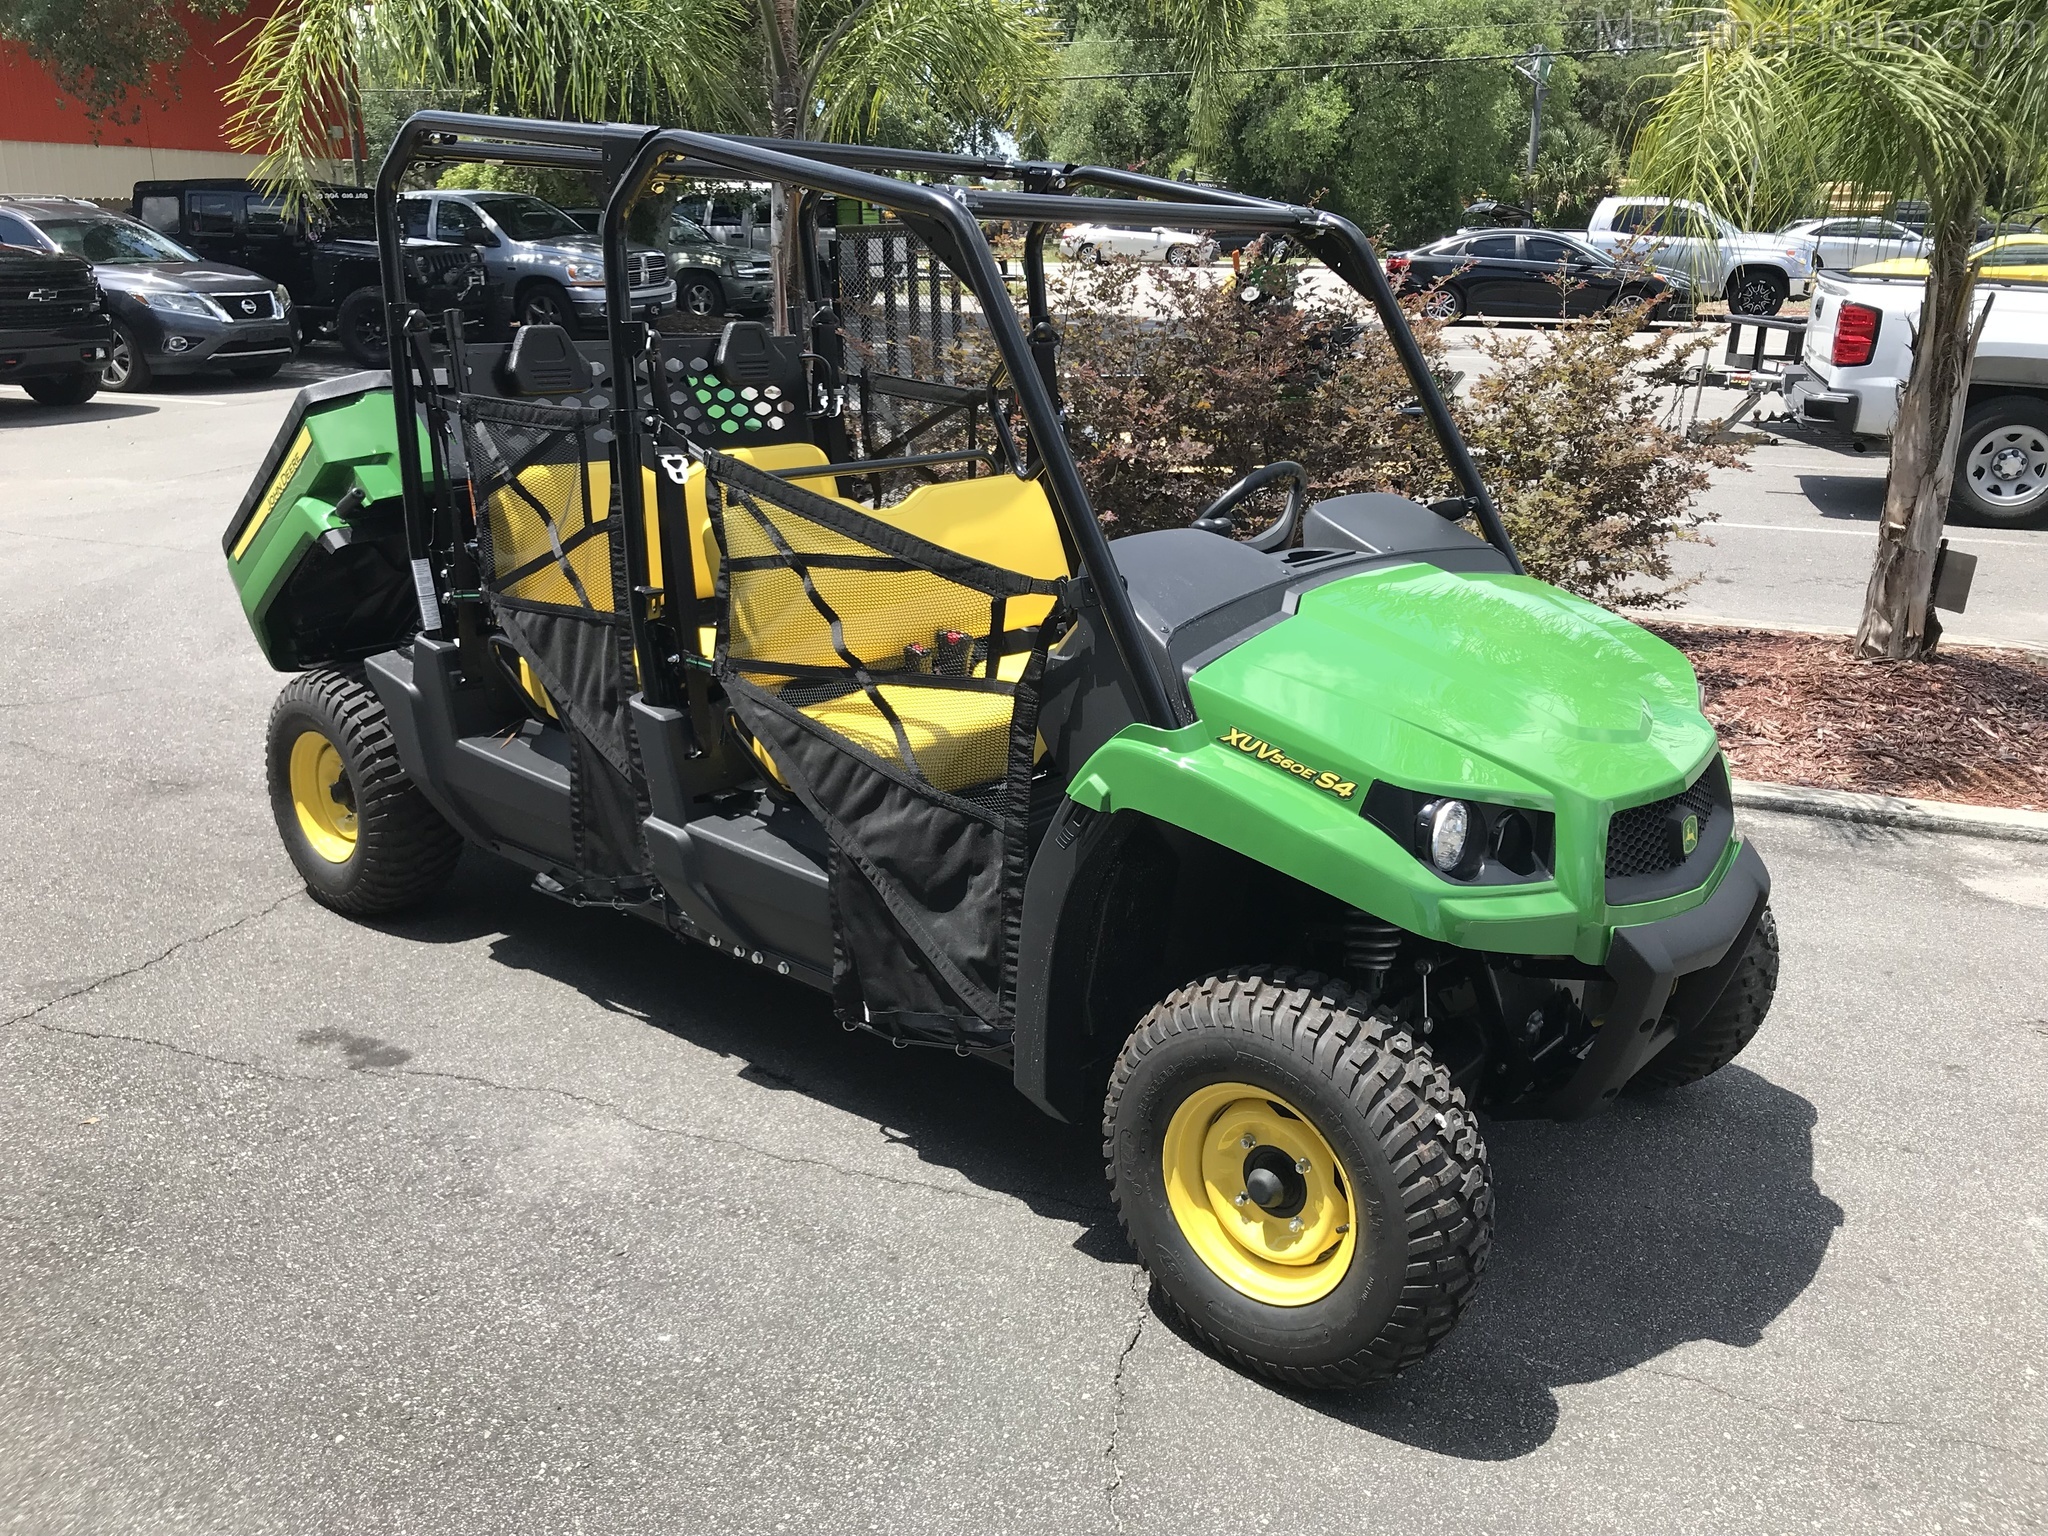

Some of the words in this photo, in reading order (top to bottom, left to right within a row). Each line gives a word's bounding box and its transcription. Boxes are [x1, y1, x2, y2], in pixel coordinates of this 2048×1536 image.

[267, 482, 284, 511] JOHN
[281, 452, 301, 486] DEERE
[1218, 726, 1318, 780] XUV560E
[1313, 770, 1358, 798] S4
